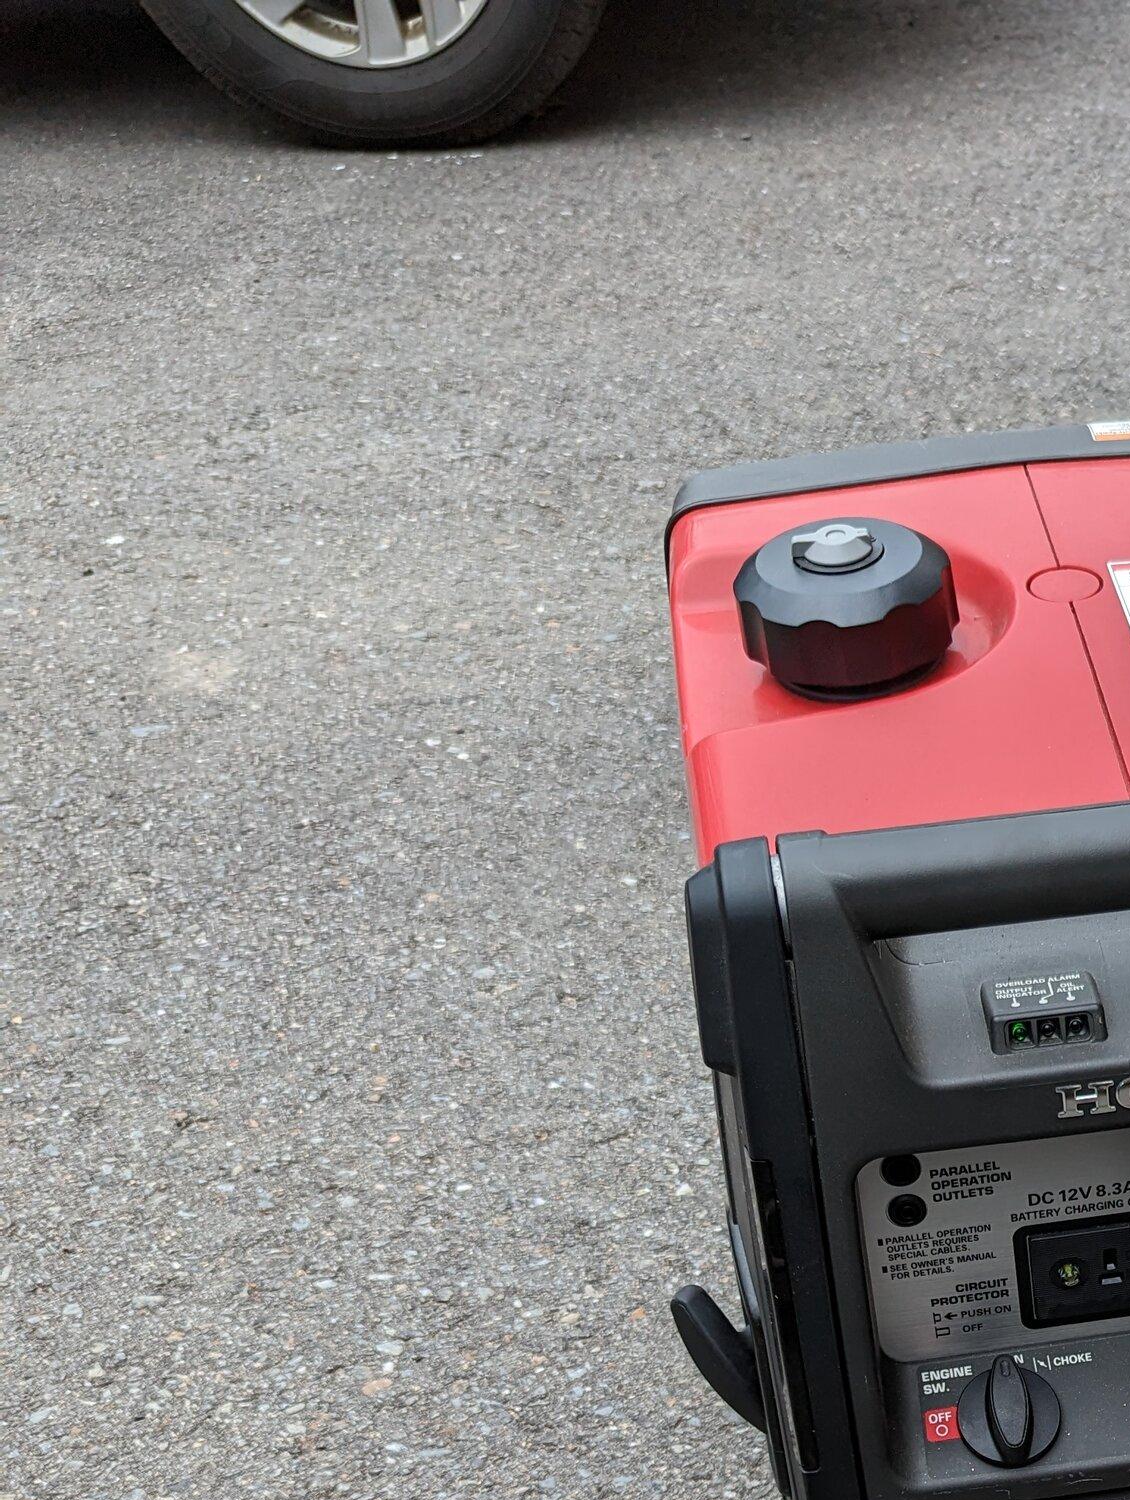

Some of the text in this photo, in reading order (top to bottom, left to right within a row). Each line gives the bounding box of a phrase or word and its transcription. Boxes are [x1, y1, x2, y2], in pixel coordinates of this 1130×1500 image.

[995, 974, 1080, 988] OVERLOAD ALARM
[995, 986, 1033, 994] OUTPUT
[996, 989, 1047, 1000] INDICATOR
[1056, 985, 1084, 993] ALERT
[930, 1161, 1000, 1179] PARALLEL
[932, 1172, 1012, 1190] OPERATION
[932, 1186, 994, 1202] OUTLETS
[1028, 1192, 1054, 1206] DC
[1059, 1185, 1092, 1202] 12V
[1011, 1207, 1061, 1222] BATTERY
[1064, 1199, 1124, 1214] CHARGING
[886, 1224, 992, 1246] PARALLEL OPERATION
[887, 1234, 980, 1254] OUTLETS REQUIRES
[888, 1244, 970, 1262] SPECIAL CABLES.
[890, 1252, 997, 1272] SEE OWNER'S MANUAL
[891, 1266, 954, 1280] FOR DETAILS.
[956, 1278, 1008, 1292] CIRCUIT
[930, 1289, 1010, 1307] PROTECTOR
[960, 1305, 1012, 1318] PUSH ON
[962, 1323, 984, 1333] OFF
[1053, 1352, 1092, 1366] CHOKE
[921, 1366, 972, 1382] ENGINE
[923, 1382, 950, 1395] SW.
[928, 1411, 952, 1424] OFF
